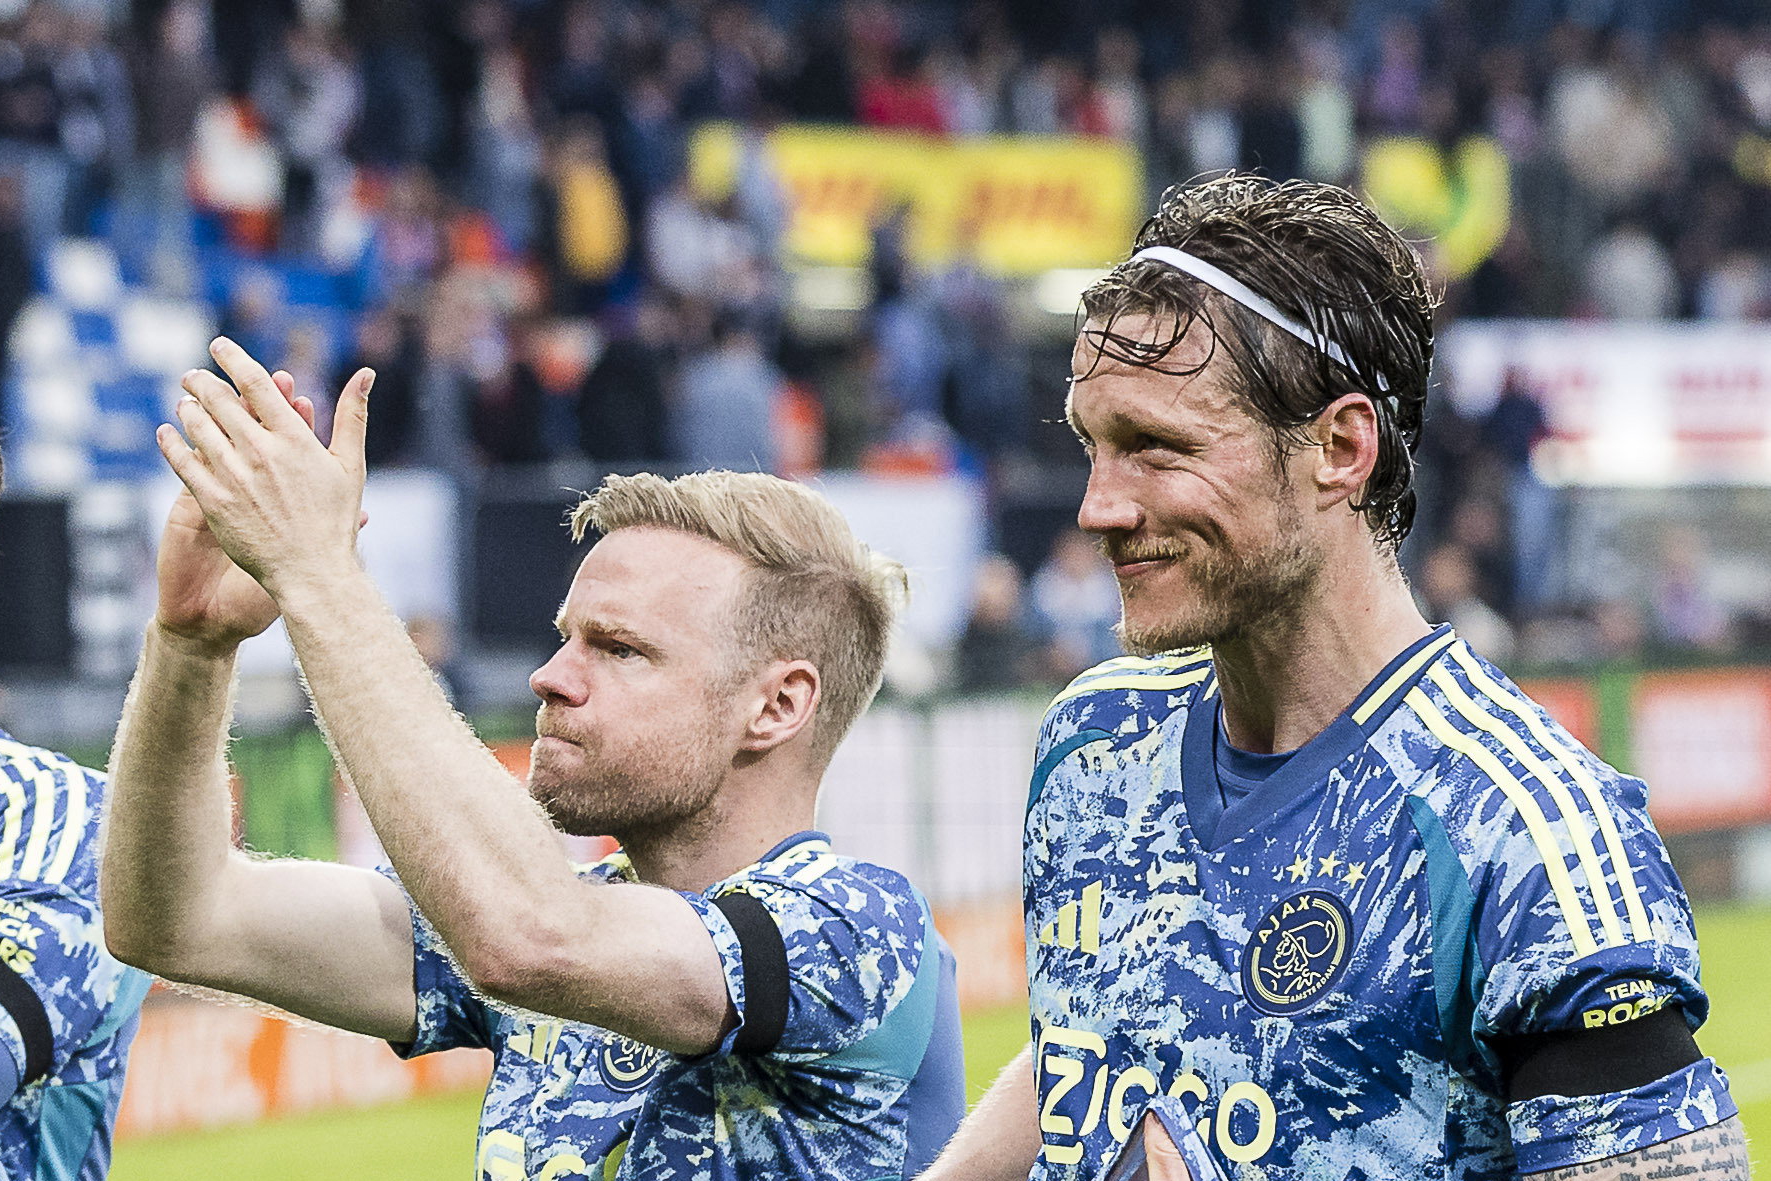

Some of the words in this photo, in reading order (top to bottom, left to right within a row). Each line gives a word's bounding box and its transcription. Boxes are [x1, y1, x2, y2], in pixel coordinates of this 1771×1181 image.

[1258, 894, 1310, 944] AJAX
[1289, 963, 1339, 1004] AMSTERDAM
[1604, 979, 1656, 1001] TEAM
